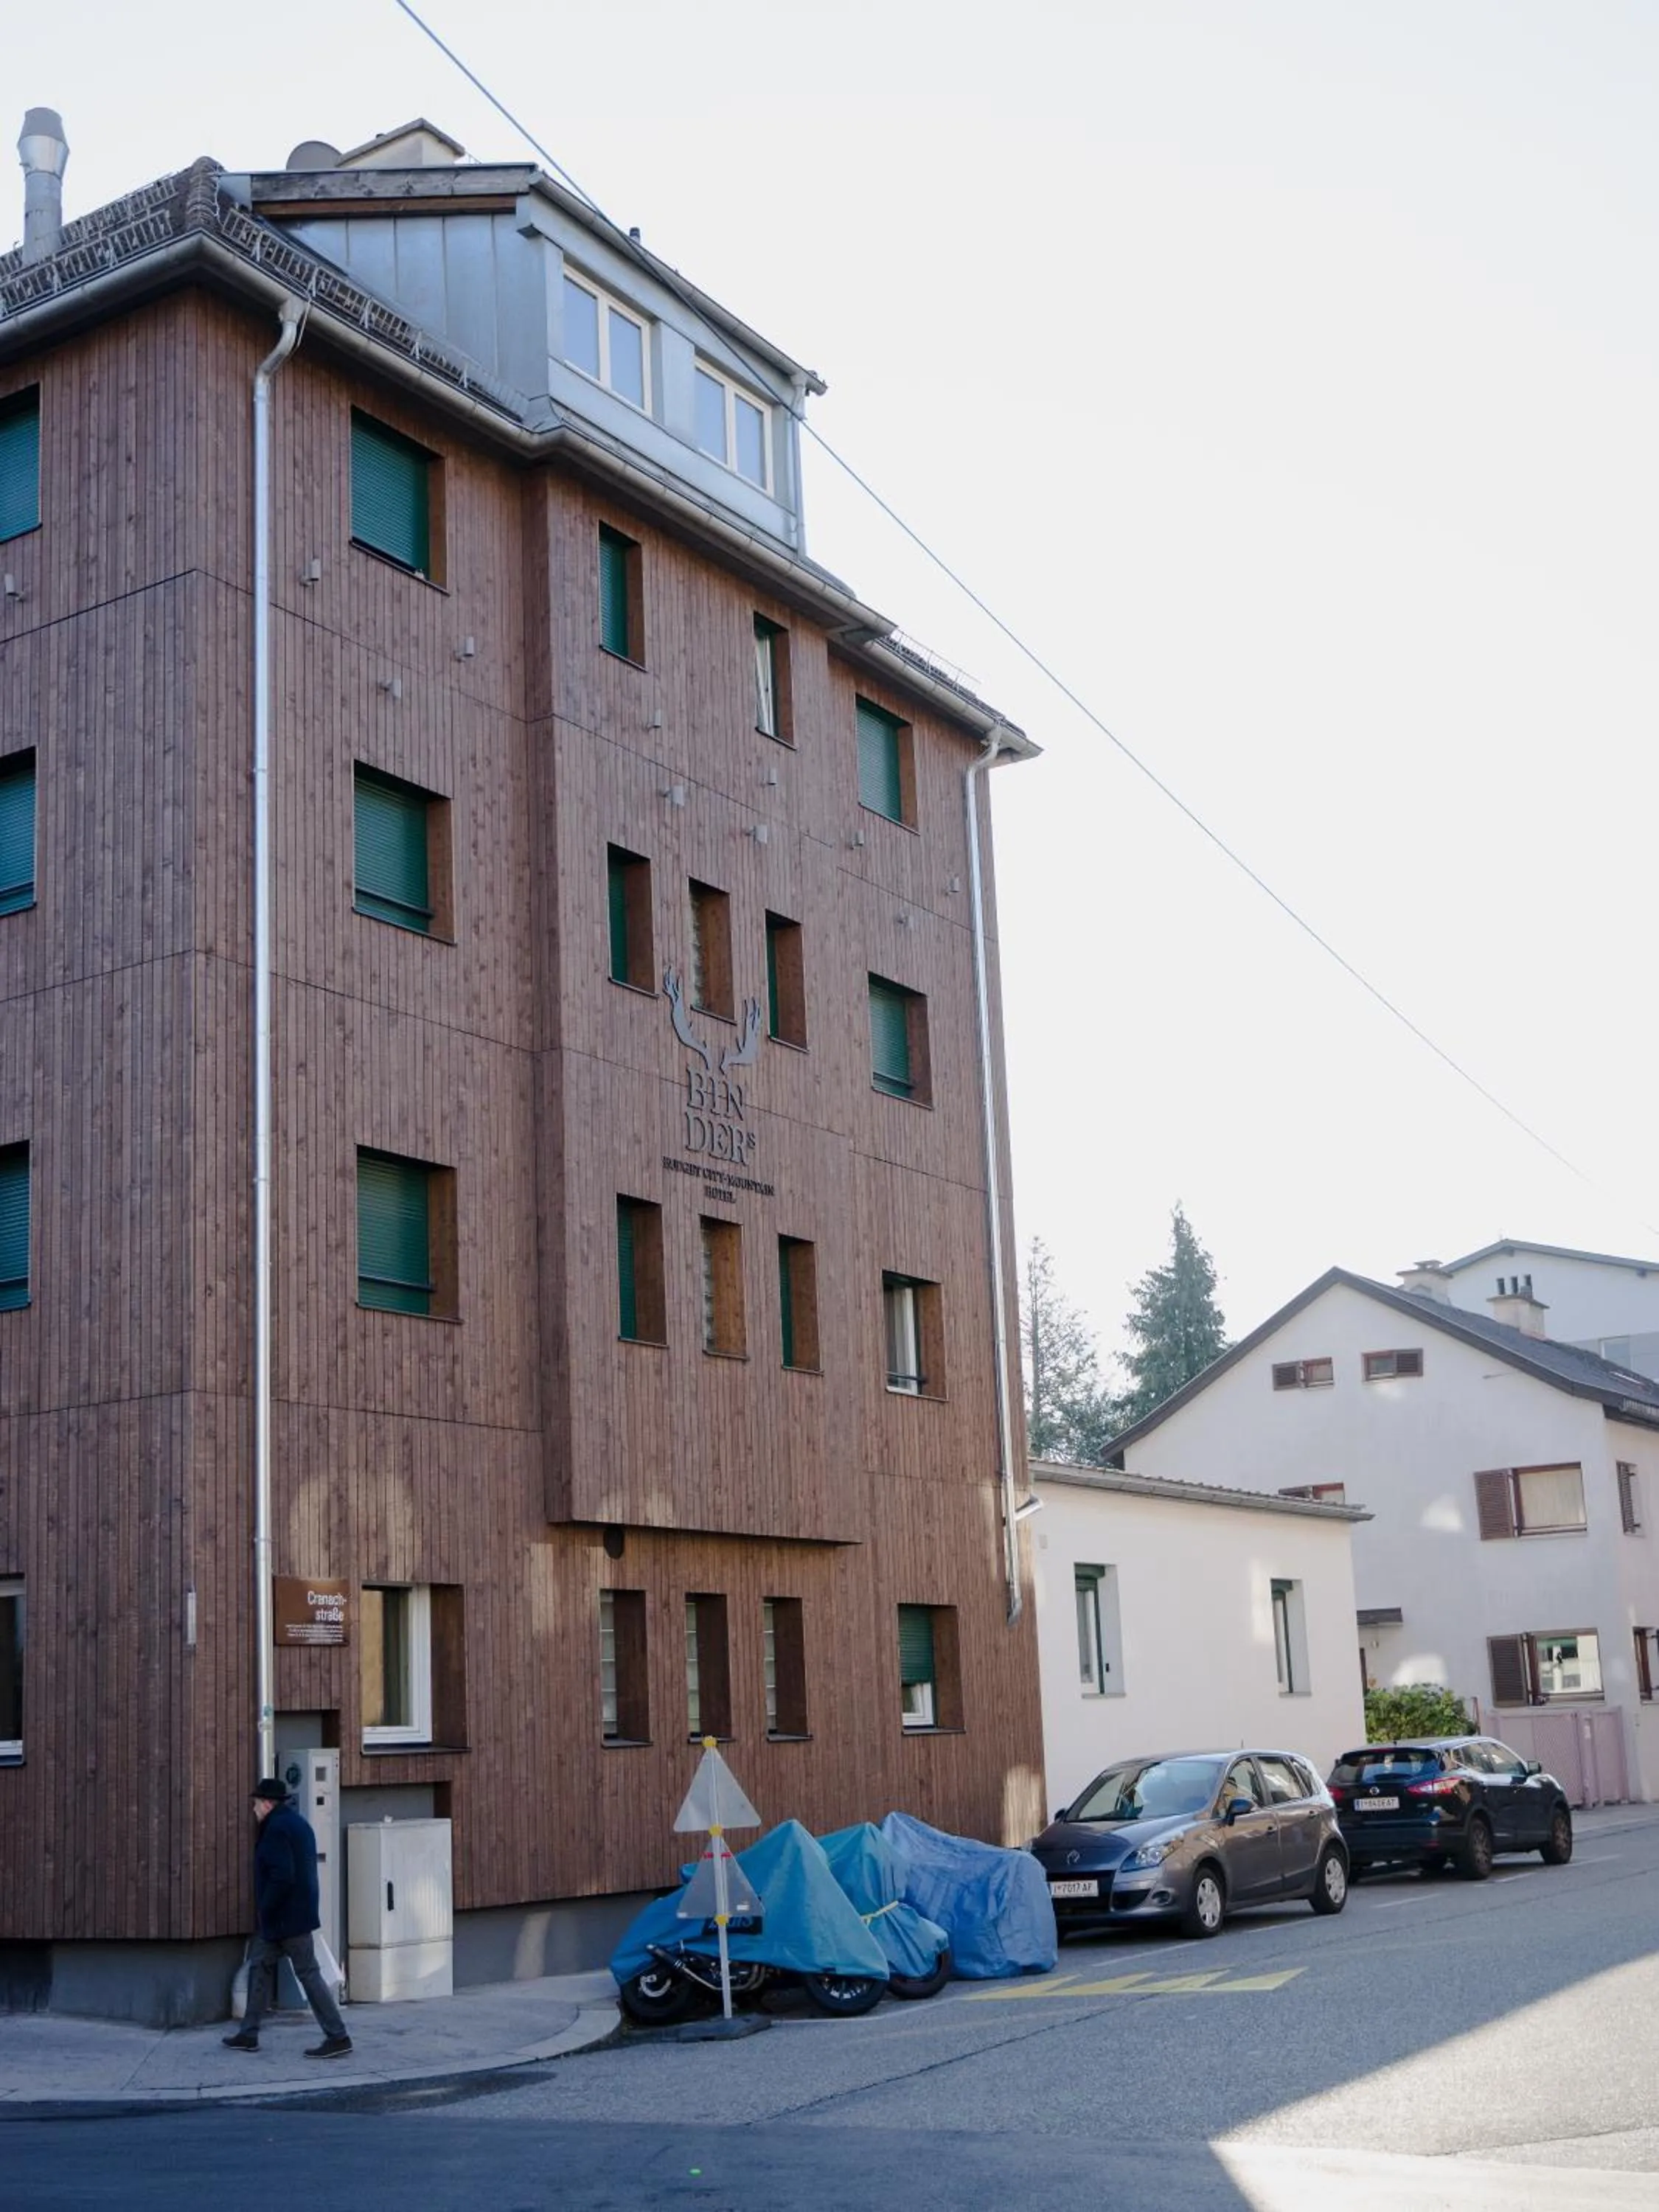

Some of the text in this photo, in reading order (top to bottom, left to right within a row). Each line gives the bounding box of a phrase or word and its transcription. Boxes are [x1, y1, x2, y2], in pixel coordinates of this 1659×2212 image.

[686, 1066, 743, 1121] BIN
[704, 1185, 737, 1203] HOTEL
[307, 1590, 347, 1605] Cranach-
[315, 1607, 344, 1621] straße
